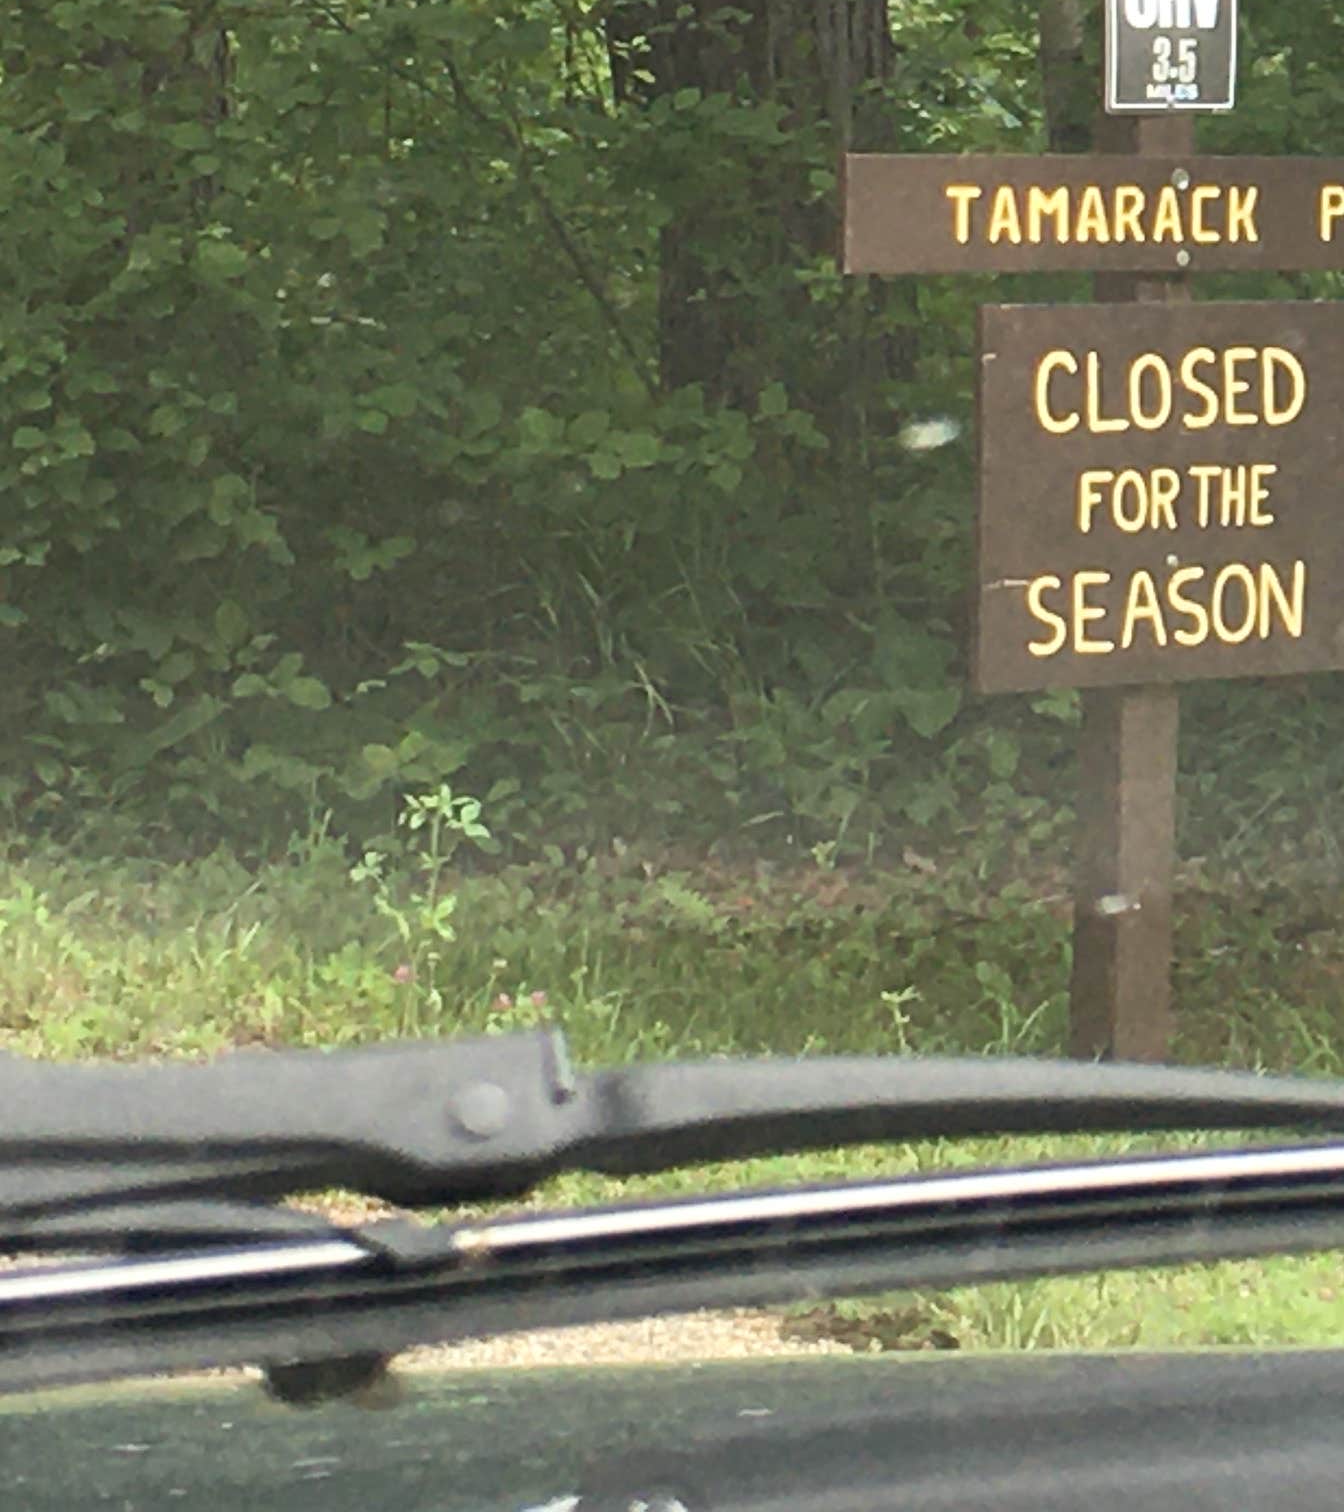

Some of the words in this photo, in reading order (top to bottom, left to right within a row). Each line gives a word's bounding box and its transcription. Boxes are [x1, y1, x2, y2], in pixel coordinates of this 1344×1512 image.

[1152, 36, 1197, 83] 3.5
[945, 184, 1259, 244] TAMARACK
[1035, 346, 1307, 433] CLOSED
[1078, 467, 1180, 533] FOR
[1188, 464, 1277, 528] THE
[1027, 560, 1304, 656] SEASON
